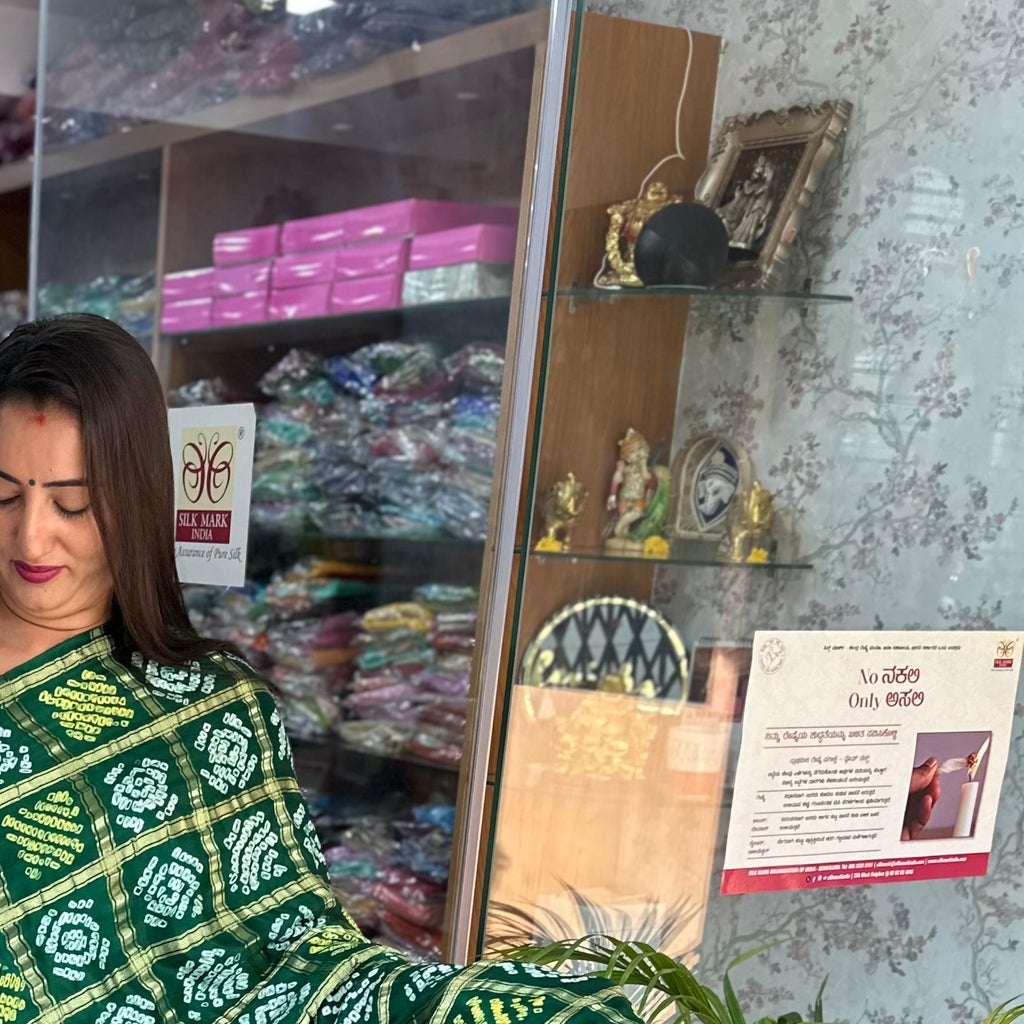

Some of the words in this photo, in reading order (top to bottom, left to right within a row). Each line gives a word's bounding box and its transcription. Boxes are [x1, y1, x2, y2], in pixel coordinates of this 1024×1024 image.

[178, 512, 197, 527] SILK
[200, 513, 229, 528] MARK
[191, 528, 213, 540] INDIA
[205, 546, 215, 562] of
[213, 547, 229, 559] Pure
[228, 547, 242, 563] Silk
[858, 667, 879, 685] No
[881, 665, 920, 684] ನಕಲಿ
[848, 692, 883, 711] Only
[886, 689, 925, 708] ಅಸಲಿ
